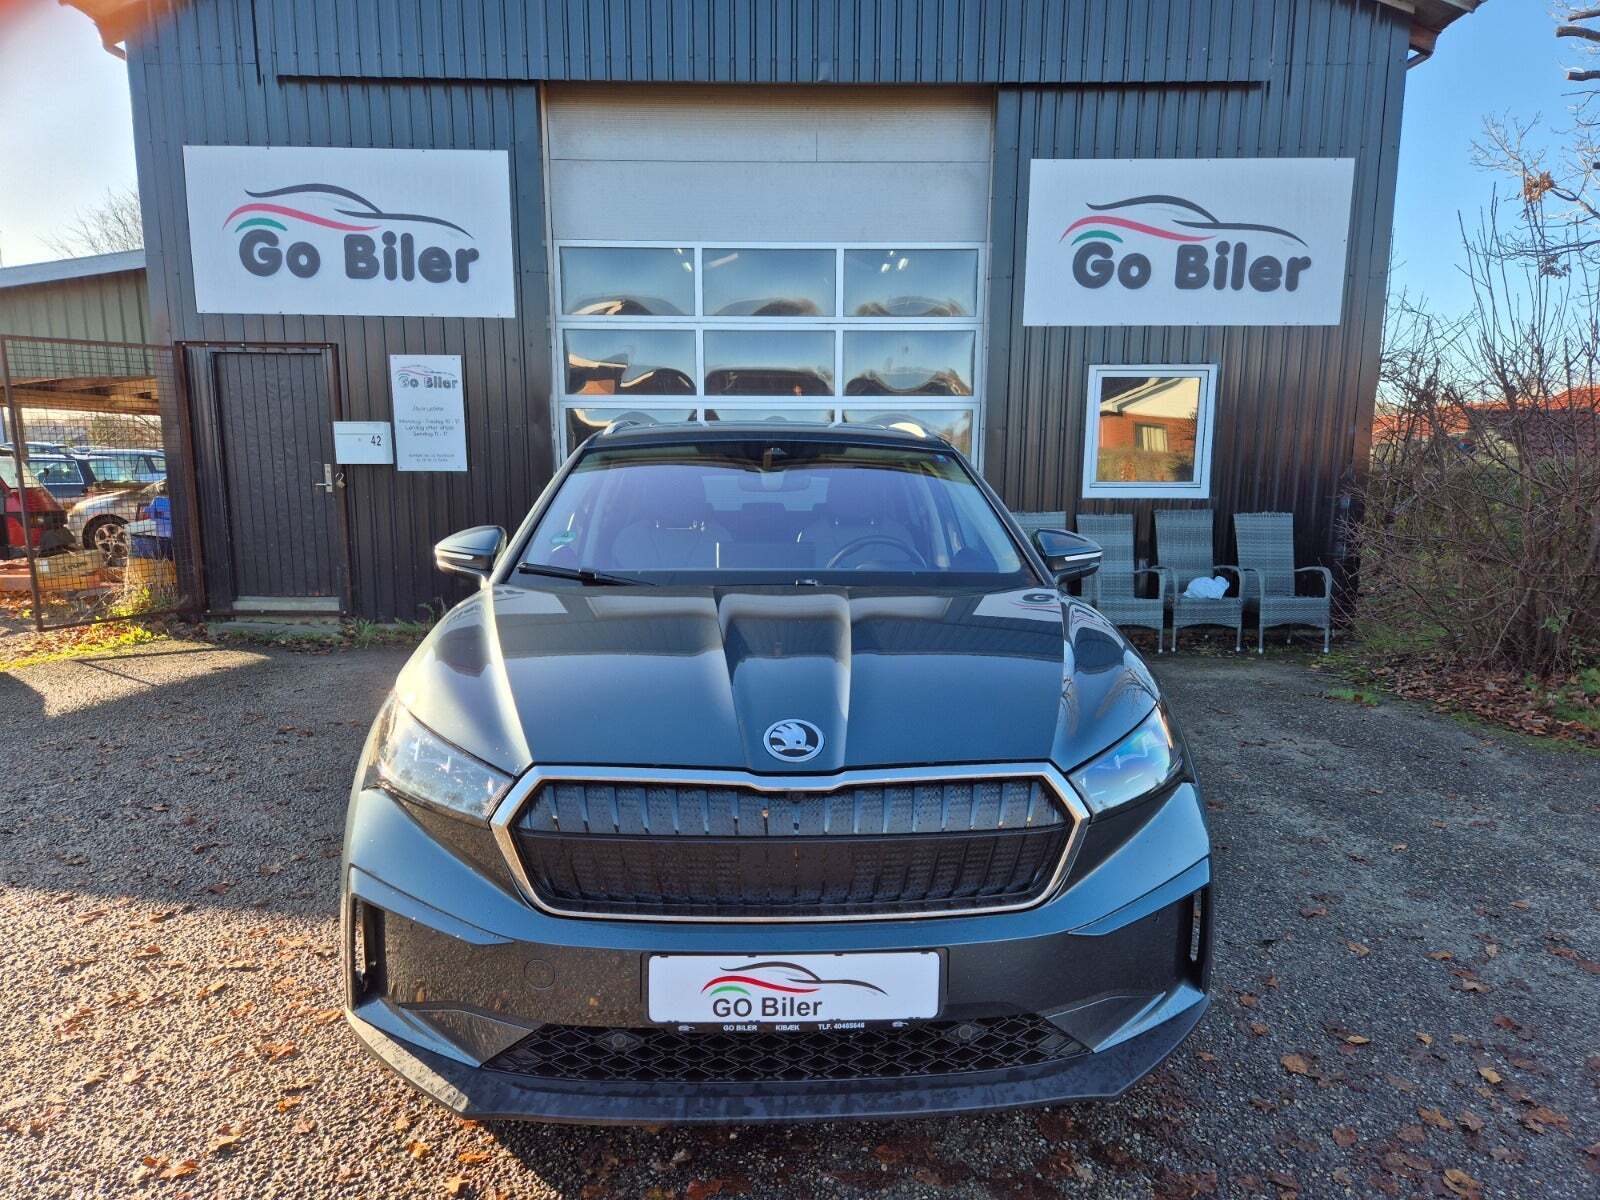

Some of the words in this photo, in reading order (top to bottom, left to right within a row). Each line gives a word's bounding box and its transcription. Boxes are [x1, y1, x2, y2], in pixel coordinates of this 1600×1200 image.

[239, 229, 320, 278] Go
[344, 230, 480, 283] Biler
[1072, 241, 1152, 289] Go
[1174, 240, 1311, 292] Biler
[371, 435, 382, 446] 42
[713, 999, 752, 1017] GO
[761, 997, 823, 1017] Biler
[723, 1024, 735, 1032] GO
[736, 1024, 758, 1032] BILER
